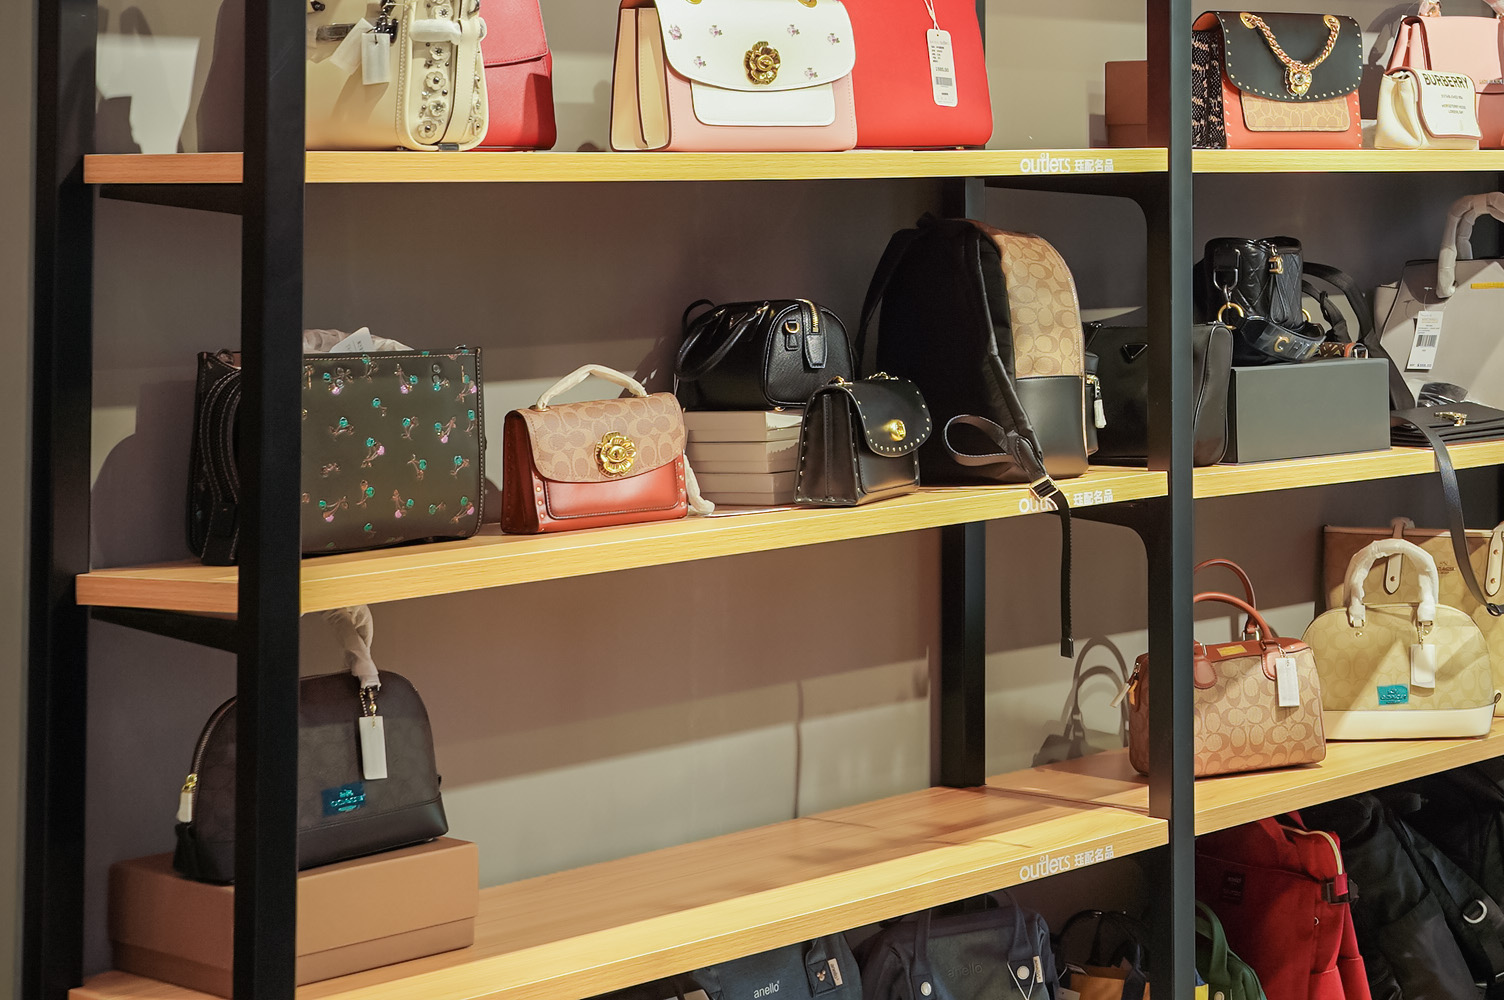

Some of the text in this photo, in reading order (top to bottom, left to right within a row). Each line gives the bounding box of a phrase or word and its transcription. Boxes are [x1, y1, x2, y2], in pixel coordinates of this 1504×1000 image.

[1422, 73, 1469, 89] BURBERRY
[1020, 152, 1071, 173] outlets
[1019, 854, 1071, 881] outlets
[753, 981, 780, 999] anello
